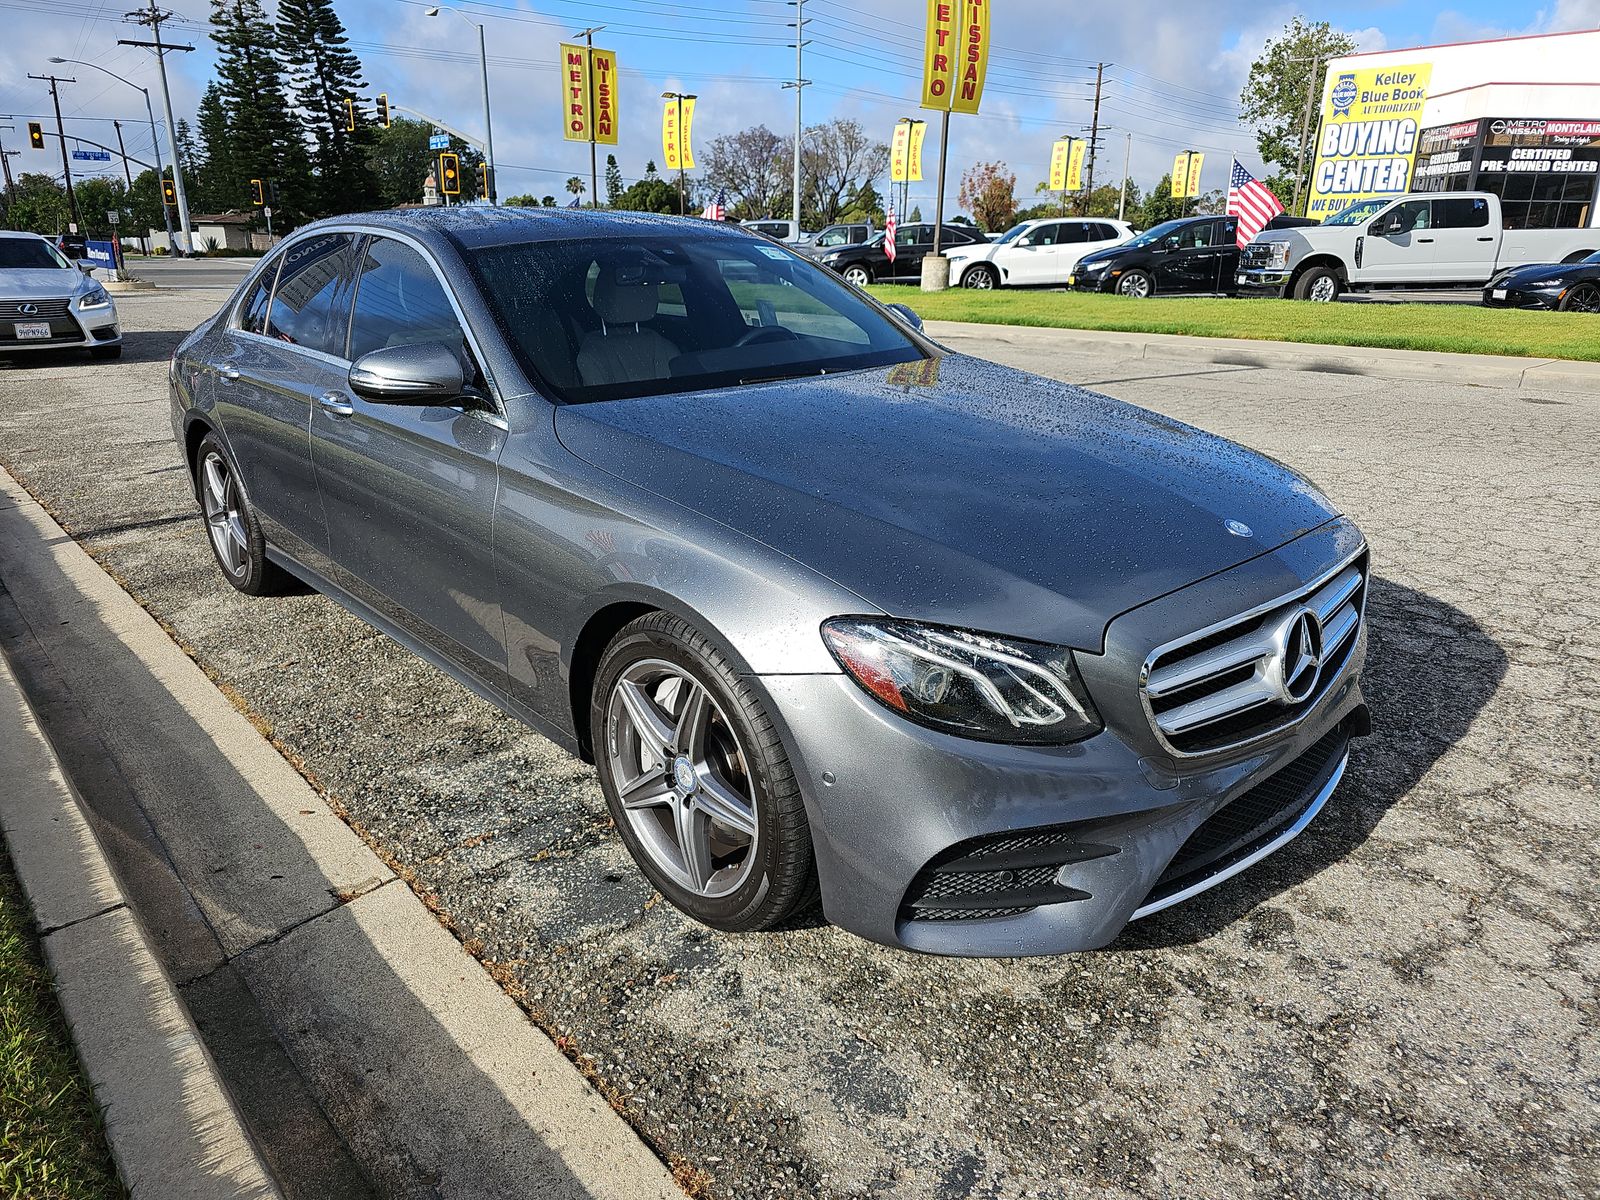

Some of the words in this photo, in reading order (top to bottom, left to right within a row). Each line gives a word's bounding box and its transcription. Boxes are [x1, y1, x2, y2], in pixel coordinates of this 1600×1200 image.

[931, 4, 950, 97] ETRO
[1375, 72, 1416, 86] Kelley
[567, 53, 584, 133] METRO
[597, 57, 612, 136] NISSAN
[1361, 91, 1389, 103] Blue
[1392, 88, 1425, 101] Book
[1361, 103, 1421, 115] AUTHORIZED
[1507, 120, 1547, 128] METRO
[1546, 123, 1600, 133] MONTCLAIR
[667, 107, 676, 163] METRO
[1321, 118, 1417, 158] BUYING
[896, 130, 905, 176] METRO
[911, 129, 920, 175] NISSAN
[1430, 152, 1459, 165] CERTIFIED
[1511, 149, 1571, 159] CERTIFIED
[1448, 160, 1472, 173] CENTER
[1480, 161, 1550, 171] PRE-OWNED
[1552, 161, 1598, 171] CENTER
[1316, 157, 1409, 194] CENTER
[1311, 199, 1325, 211] WE
[1328, 198, 1348, 211] BUY
[18, 328, 49, 337] 9HPN966
